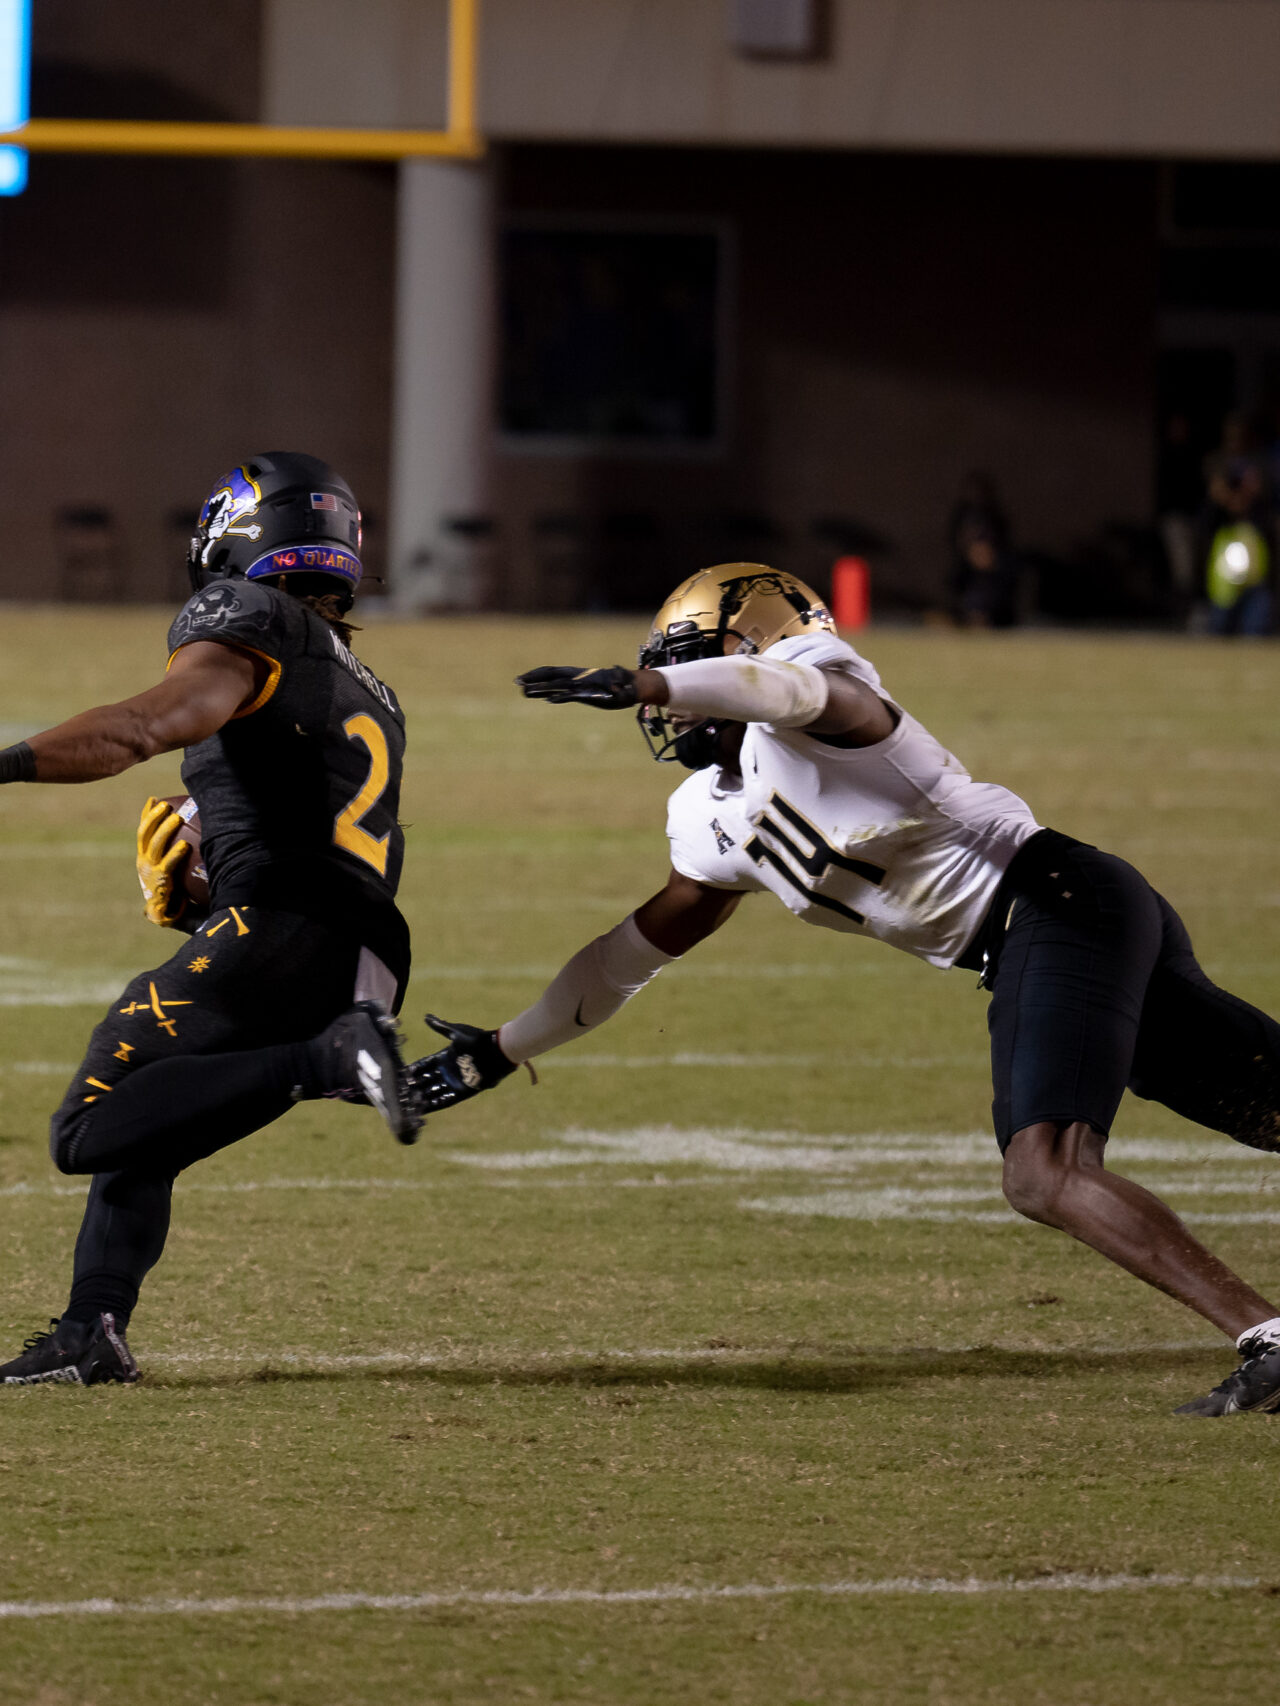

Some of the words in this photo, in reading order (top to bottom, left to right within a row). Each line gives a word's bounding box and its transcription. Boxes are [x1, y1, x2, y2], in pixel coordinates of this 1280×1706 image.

[273, 552, 297, 568] NO
[333, 712, 391, 878] 2
[743, 788, 887, 925] 14
